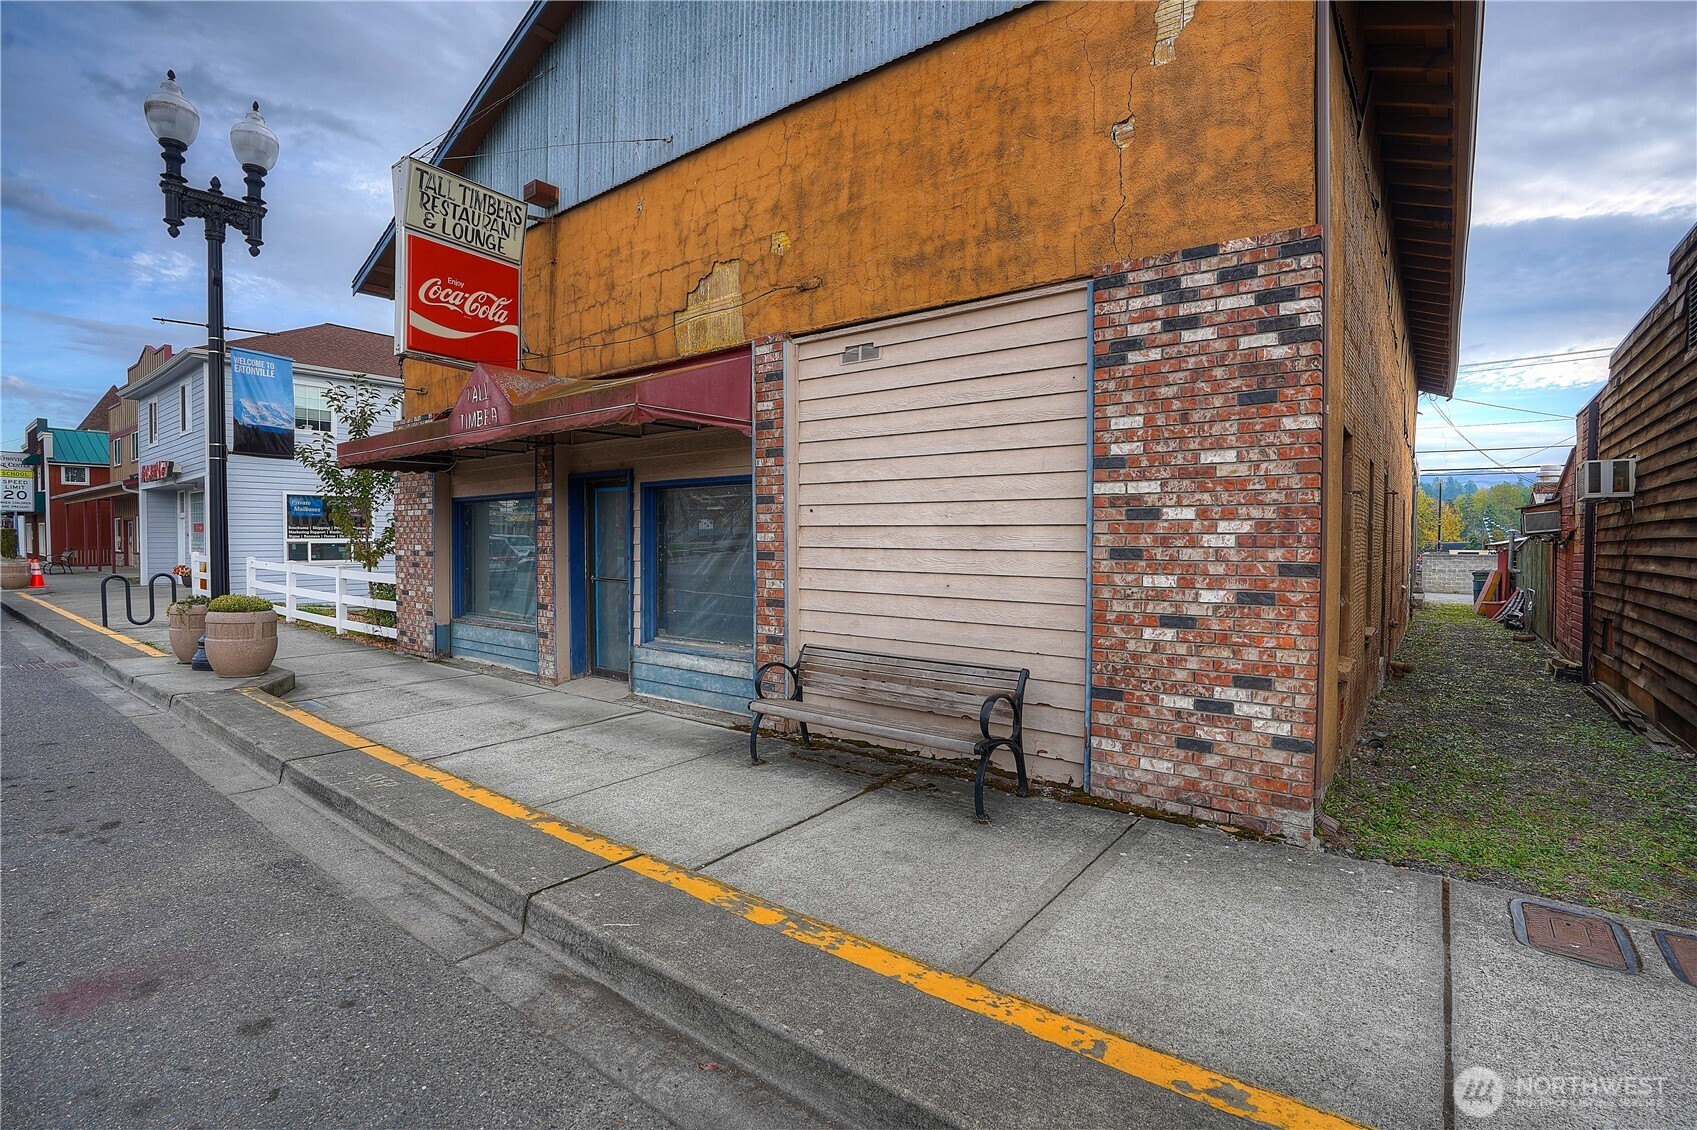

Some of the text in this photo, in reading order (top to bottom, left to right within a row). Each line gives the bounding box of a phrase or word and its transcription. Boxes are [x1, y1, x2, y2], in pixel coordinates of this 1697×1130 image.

[415, 167, 522, 226] TALL TIMBERS
[419, 190, 521, 241] RESTAURANT
[423, 212, 506, 255] & LOUNGE
[447, 277, 465, 288] Enjoy
[418, 277, 513, 324] Coca-Cola
[233, 356, 275, 370] WELCOME TO
[234, 363, 276, 378] EATONVILLE
[4, 490, 28, 500] 20
